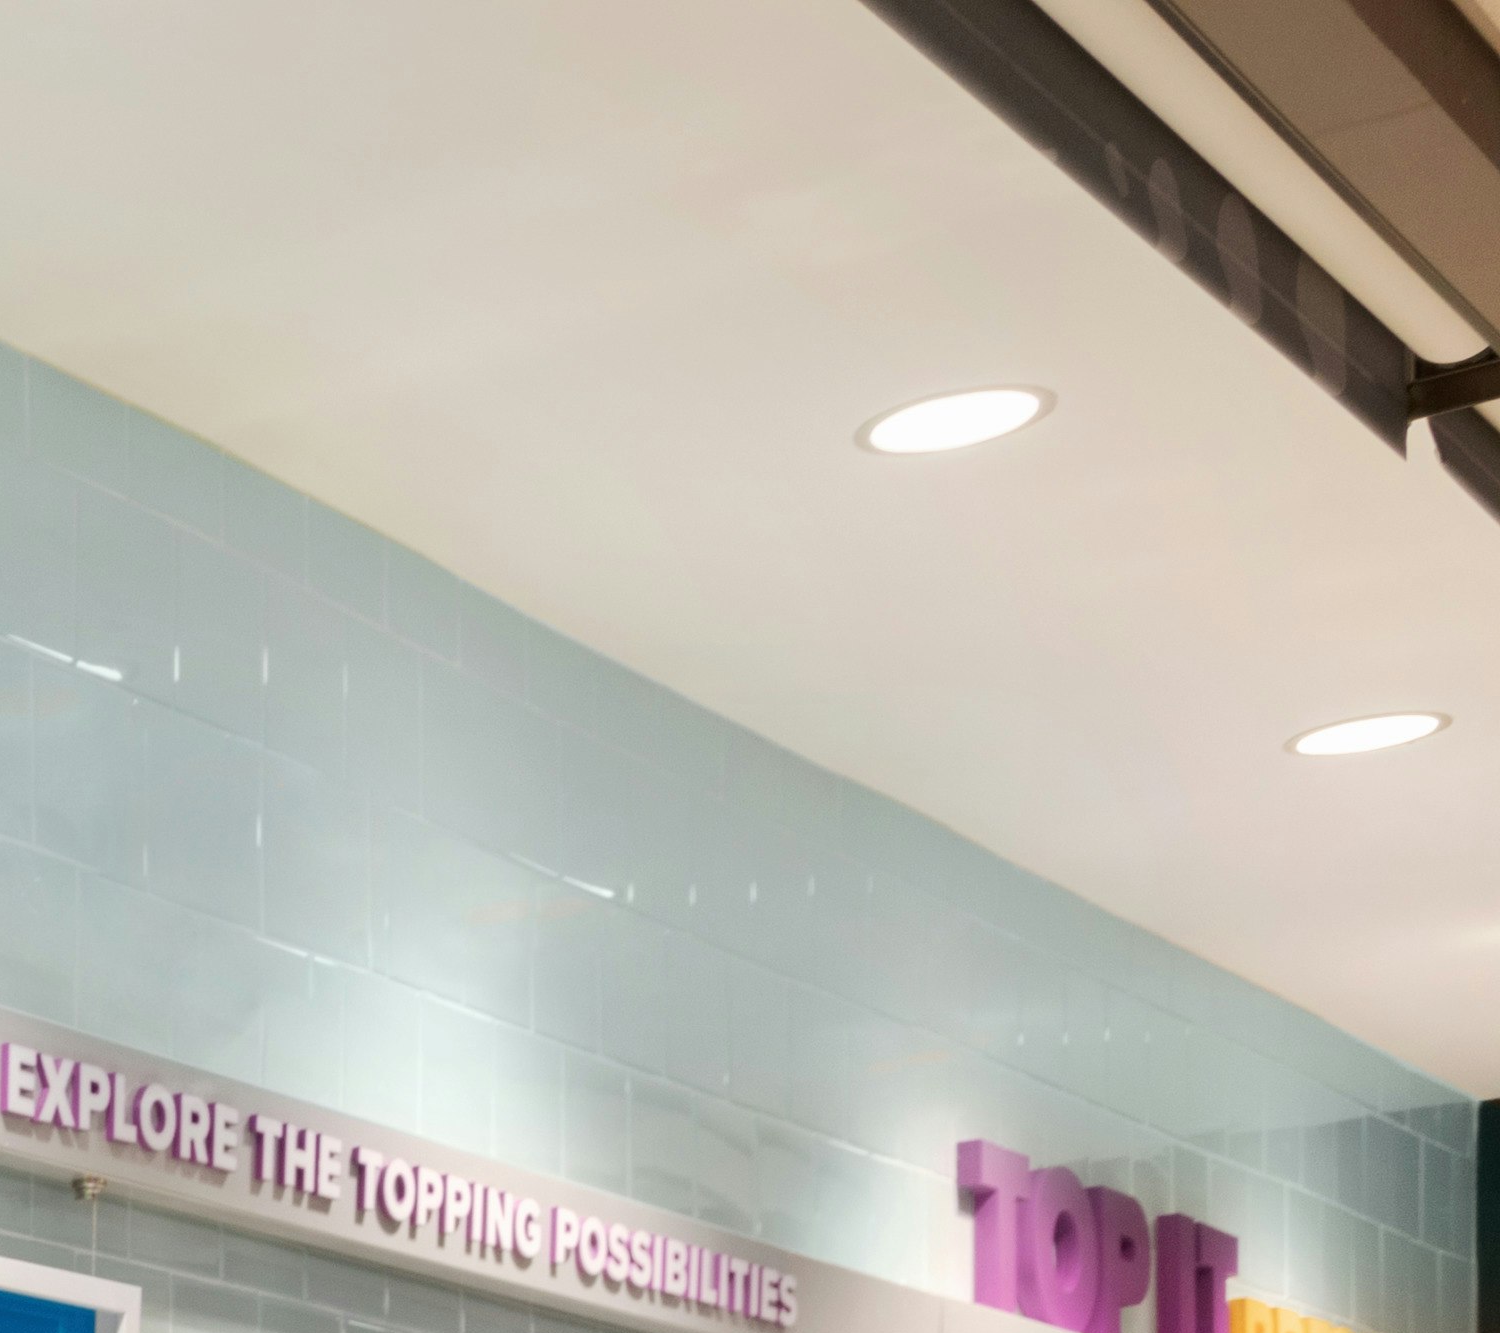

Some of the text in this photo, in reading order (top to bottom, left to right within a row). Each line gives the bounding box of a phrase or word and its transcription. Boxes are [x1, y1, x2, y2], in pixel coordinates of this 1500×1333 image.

[0, 1041, 798, 1328] EXPLORE THE TOPPING POSSIBILITIES
